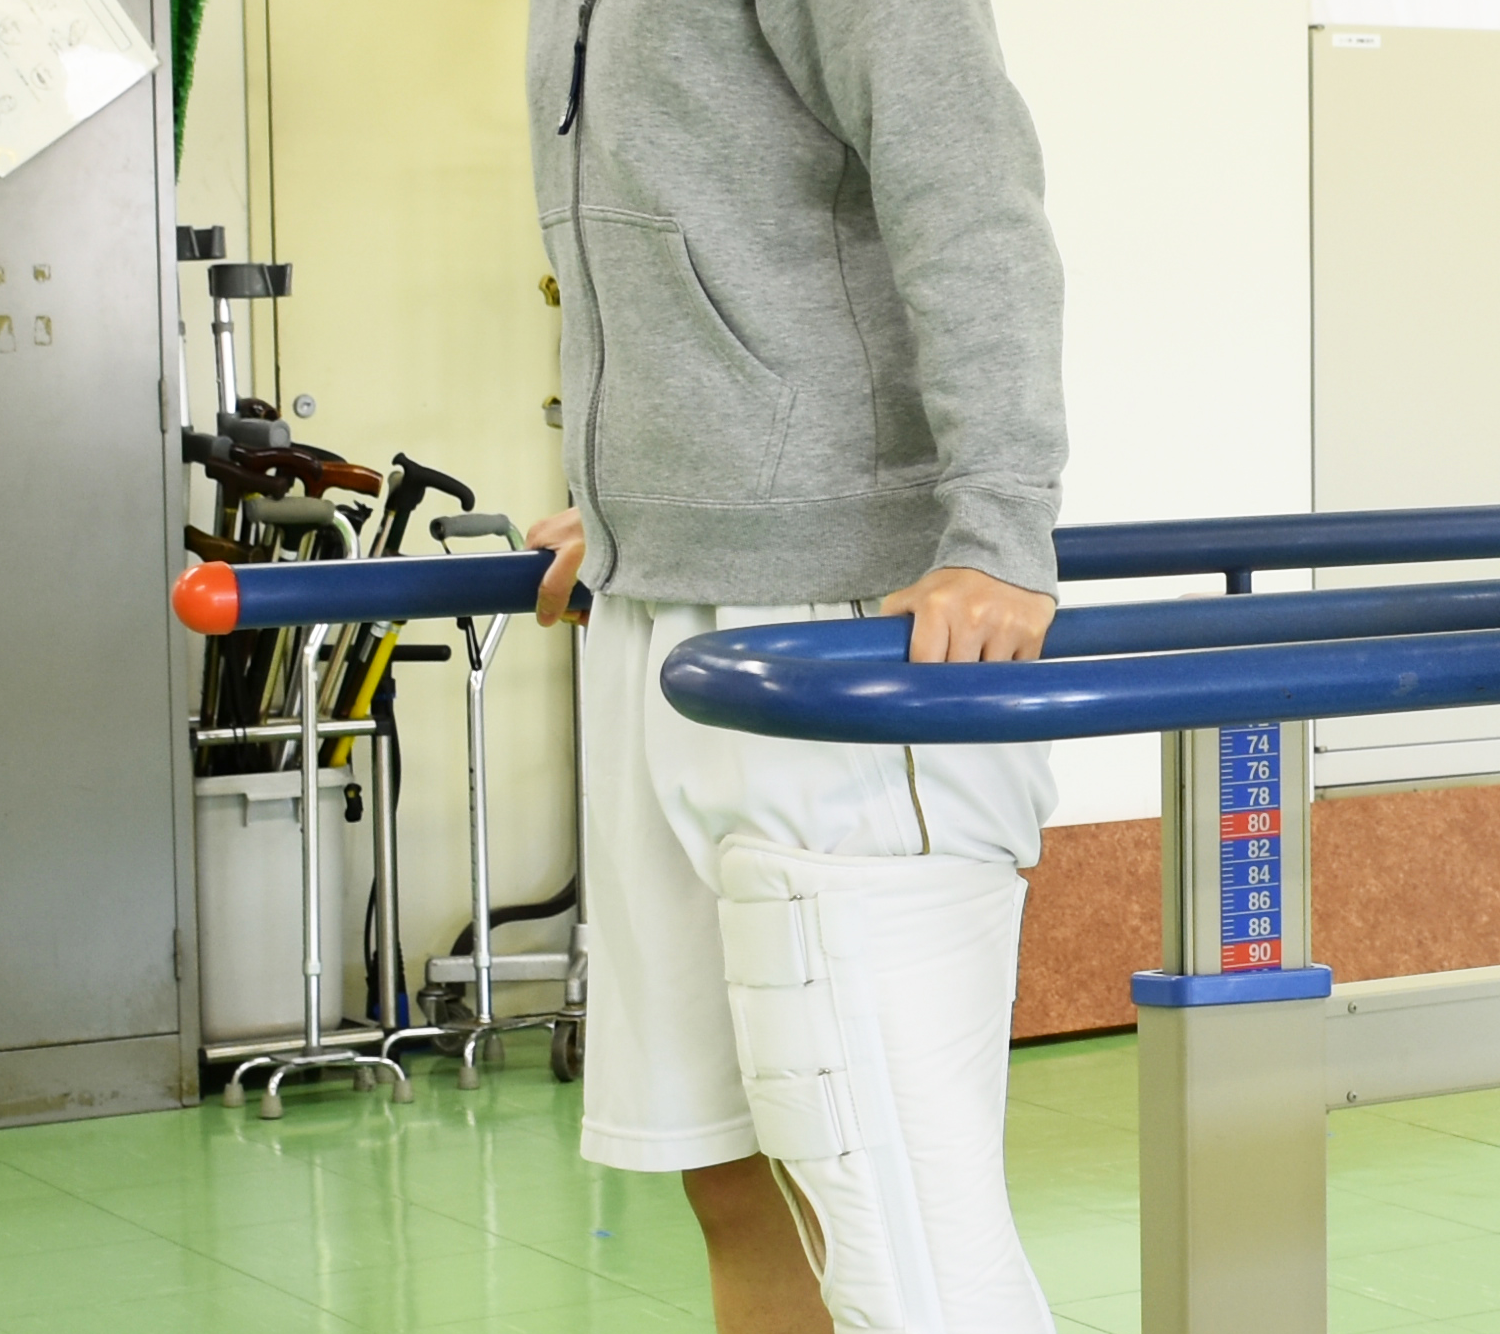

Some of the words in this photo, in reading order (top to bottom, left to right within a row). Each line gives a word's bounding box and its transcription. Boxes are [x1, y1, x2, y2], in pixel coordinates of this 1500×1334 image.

[1246, 734, 1269, 754] 74
[1246, 760, 1269, 780] 76
[1246, 786, 1269, 806] 78
[1246, 812, 1269, 833] 80
[1247, 838, 1270, 859] 82
[1247, 864, 1270, 885] 84
[1247, 890, 1270, 910] 86
[1247, 916, 1270, 937] 88
[1248, 942, 1271, 963] 90
